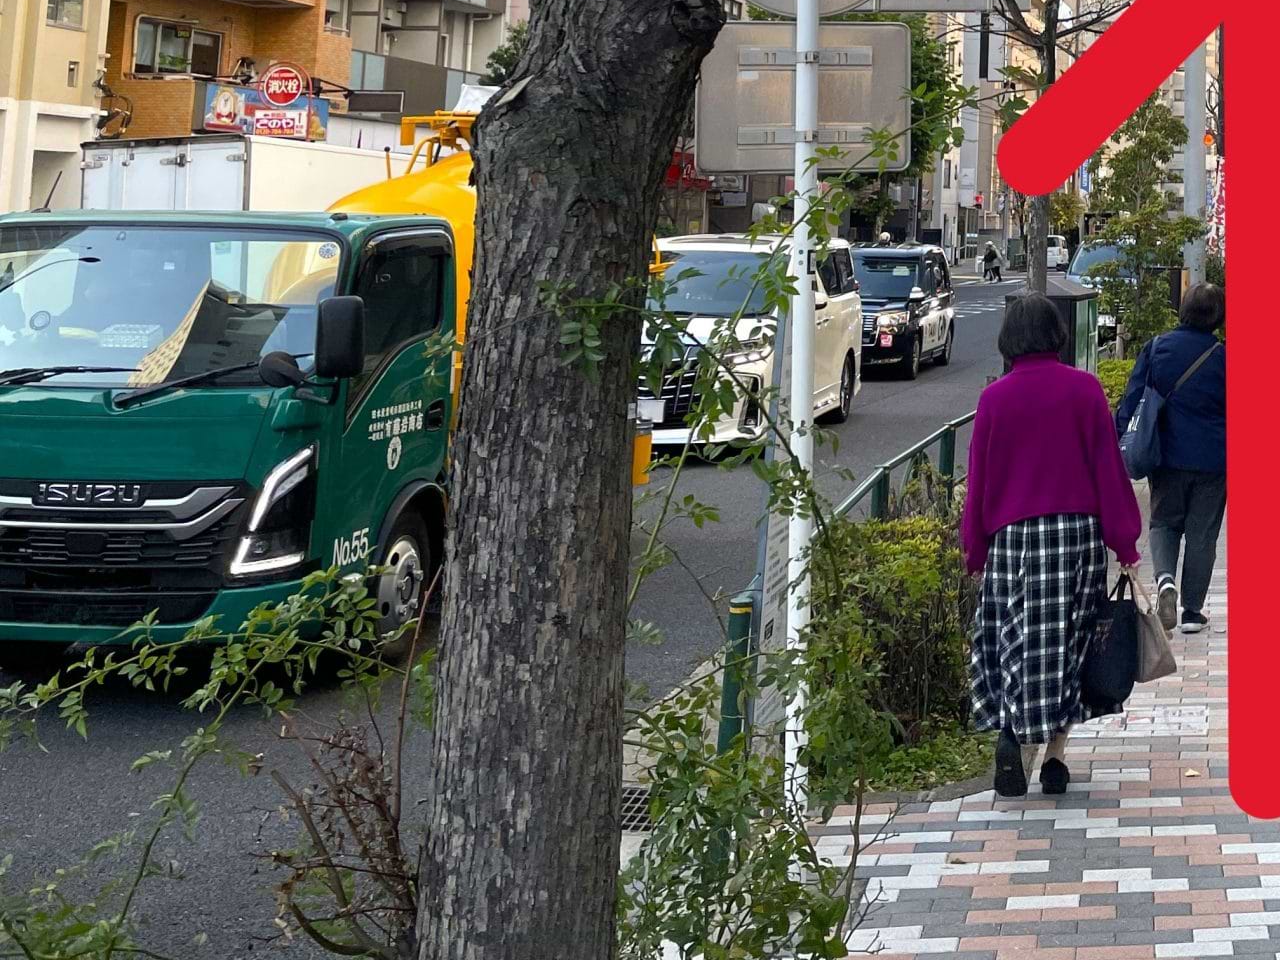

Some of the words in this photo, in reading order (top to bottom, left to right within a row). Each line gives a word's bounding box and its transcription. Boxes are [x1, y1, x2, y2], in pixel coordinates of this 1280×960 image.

[268, 79, 299, 94] 消火栓
[39, 483, 140, 503] ISUZU
[332, 527, 370, 567] No.55
